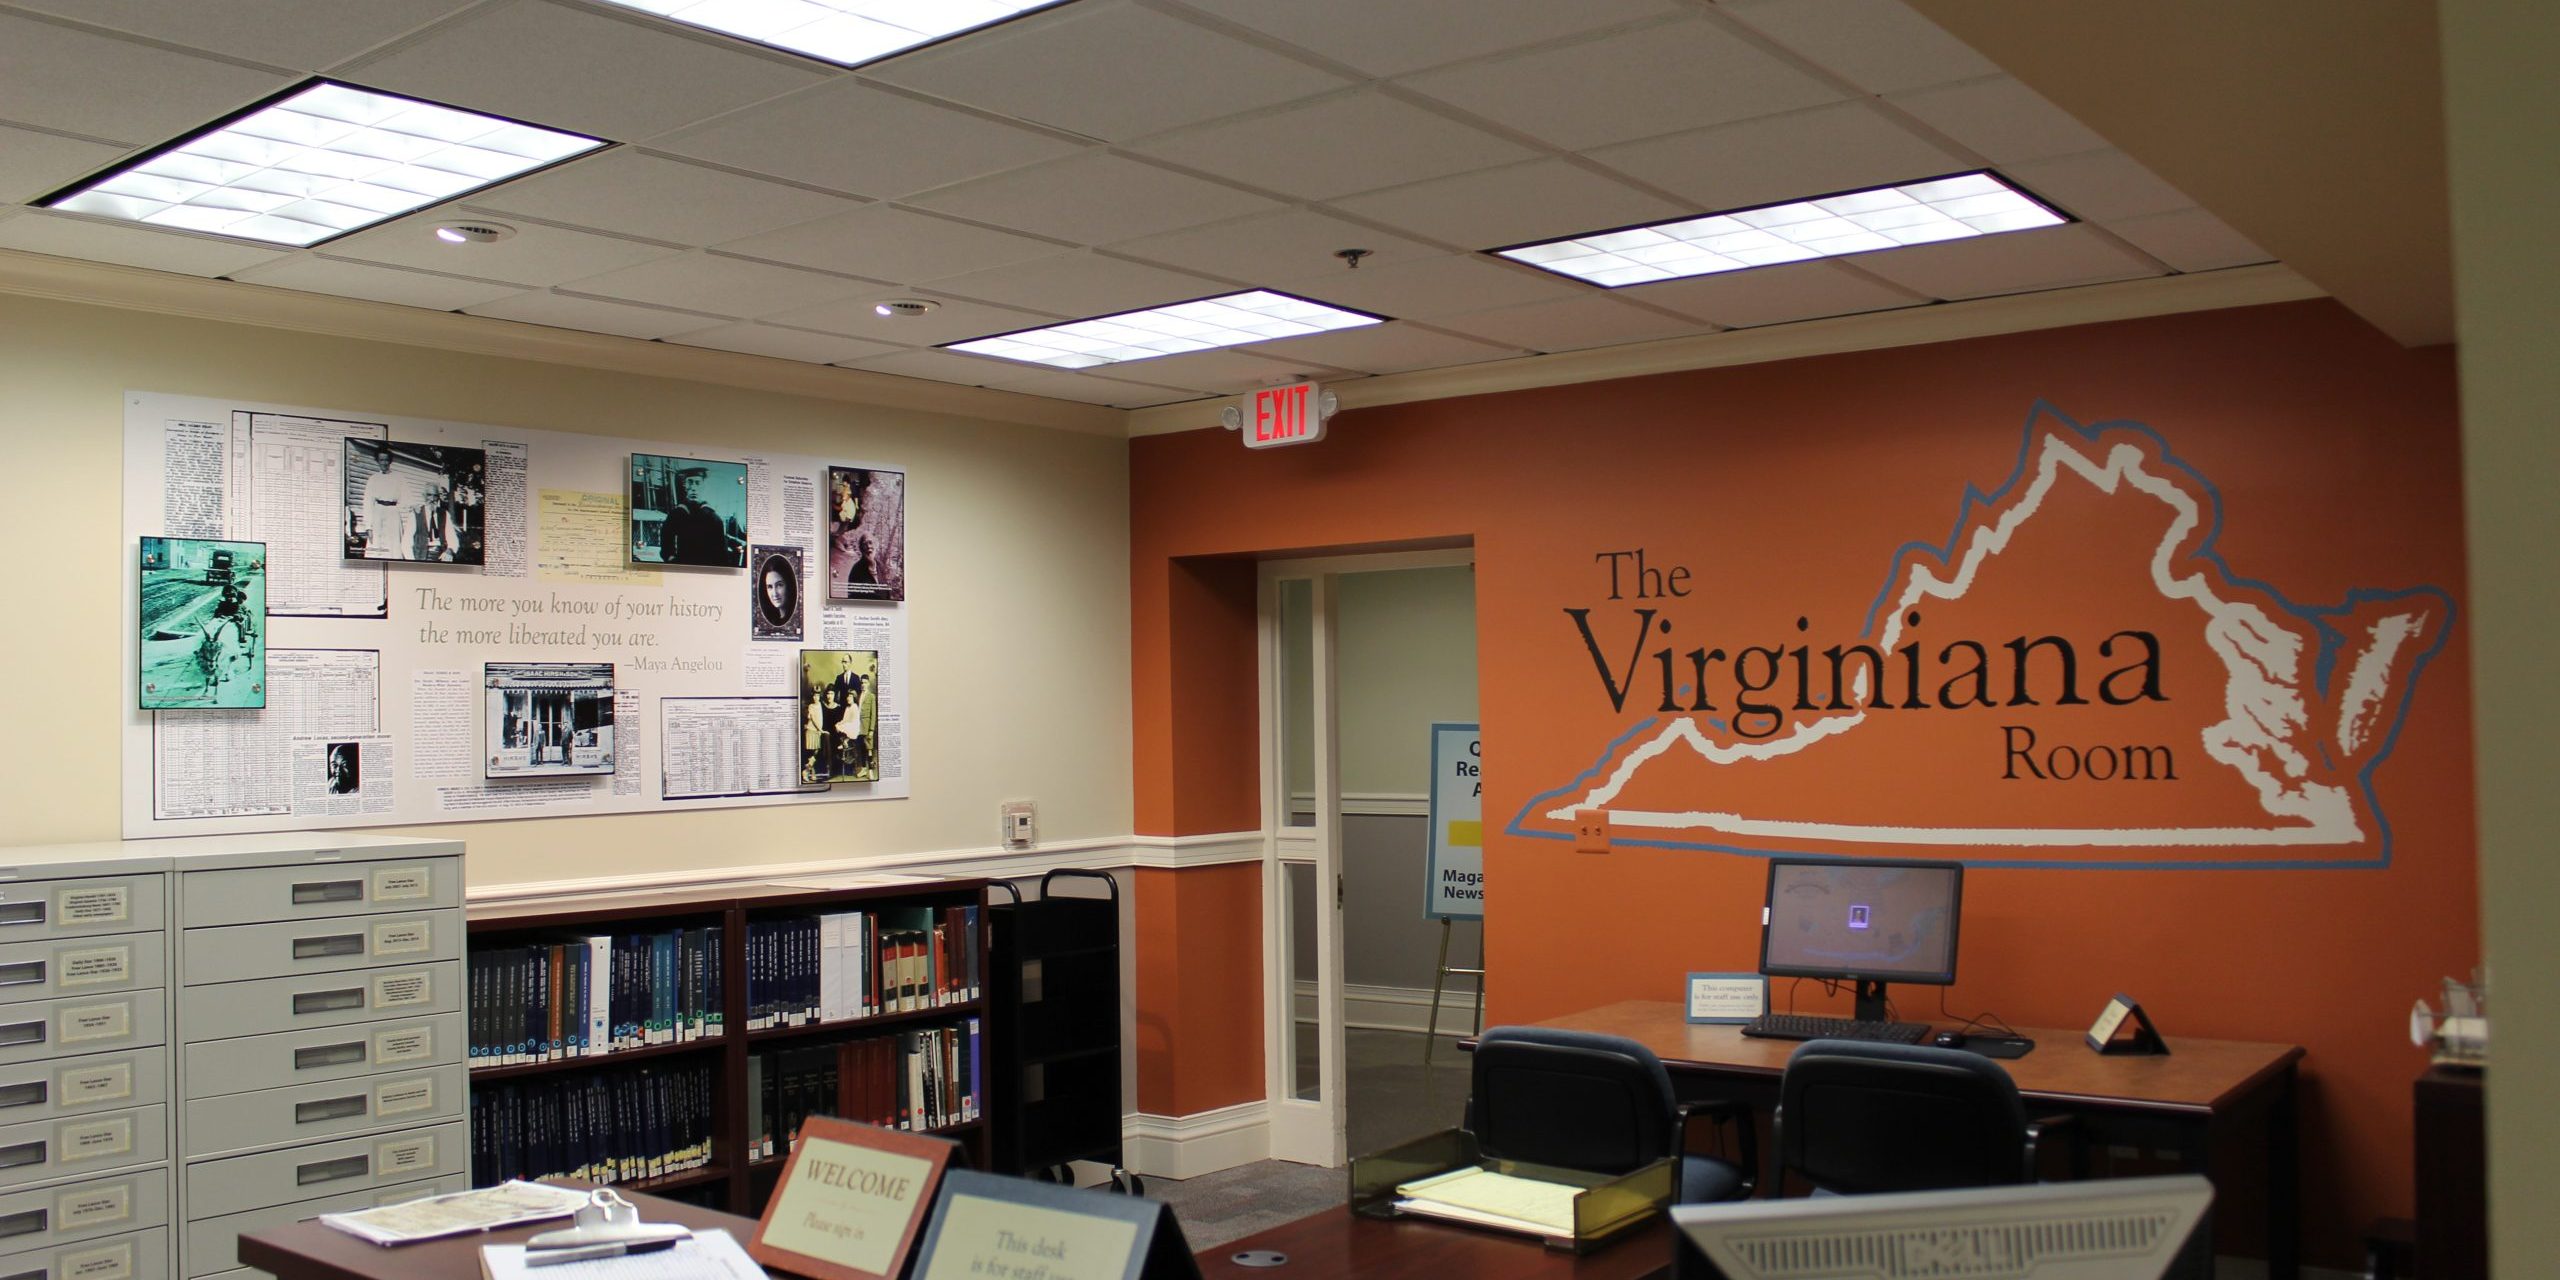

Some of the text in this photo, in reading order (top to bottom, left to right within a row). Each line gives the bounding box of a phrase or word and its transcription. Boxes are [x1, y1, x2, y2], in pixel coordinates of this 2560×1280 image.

[1256, 385, 1309, 441] EXIT
[1595, 548, 1692, 600] The
[416, 588, 723, 622] The more you know of your history
[420, 621, 659, 650] the more liberated you are.
[671, 657, 723, 673] Angelou
[1563, 608, 2171, 738] Virginiana
[2001, 725, 2179, 780] Room
[1456, 761, 1481, 777] Re
[807, 1158, 911, 1201] WELCOME
[803, 1211, 864, 1240] Please sign in
[997, 1230, 1067, 1260] This desk
[971, 1255, 983, 1273] is
[987, 1257, 1008, 1277] for
[1012, 1264, 1049, 1280] staff
